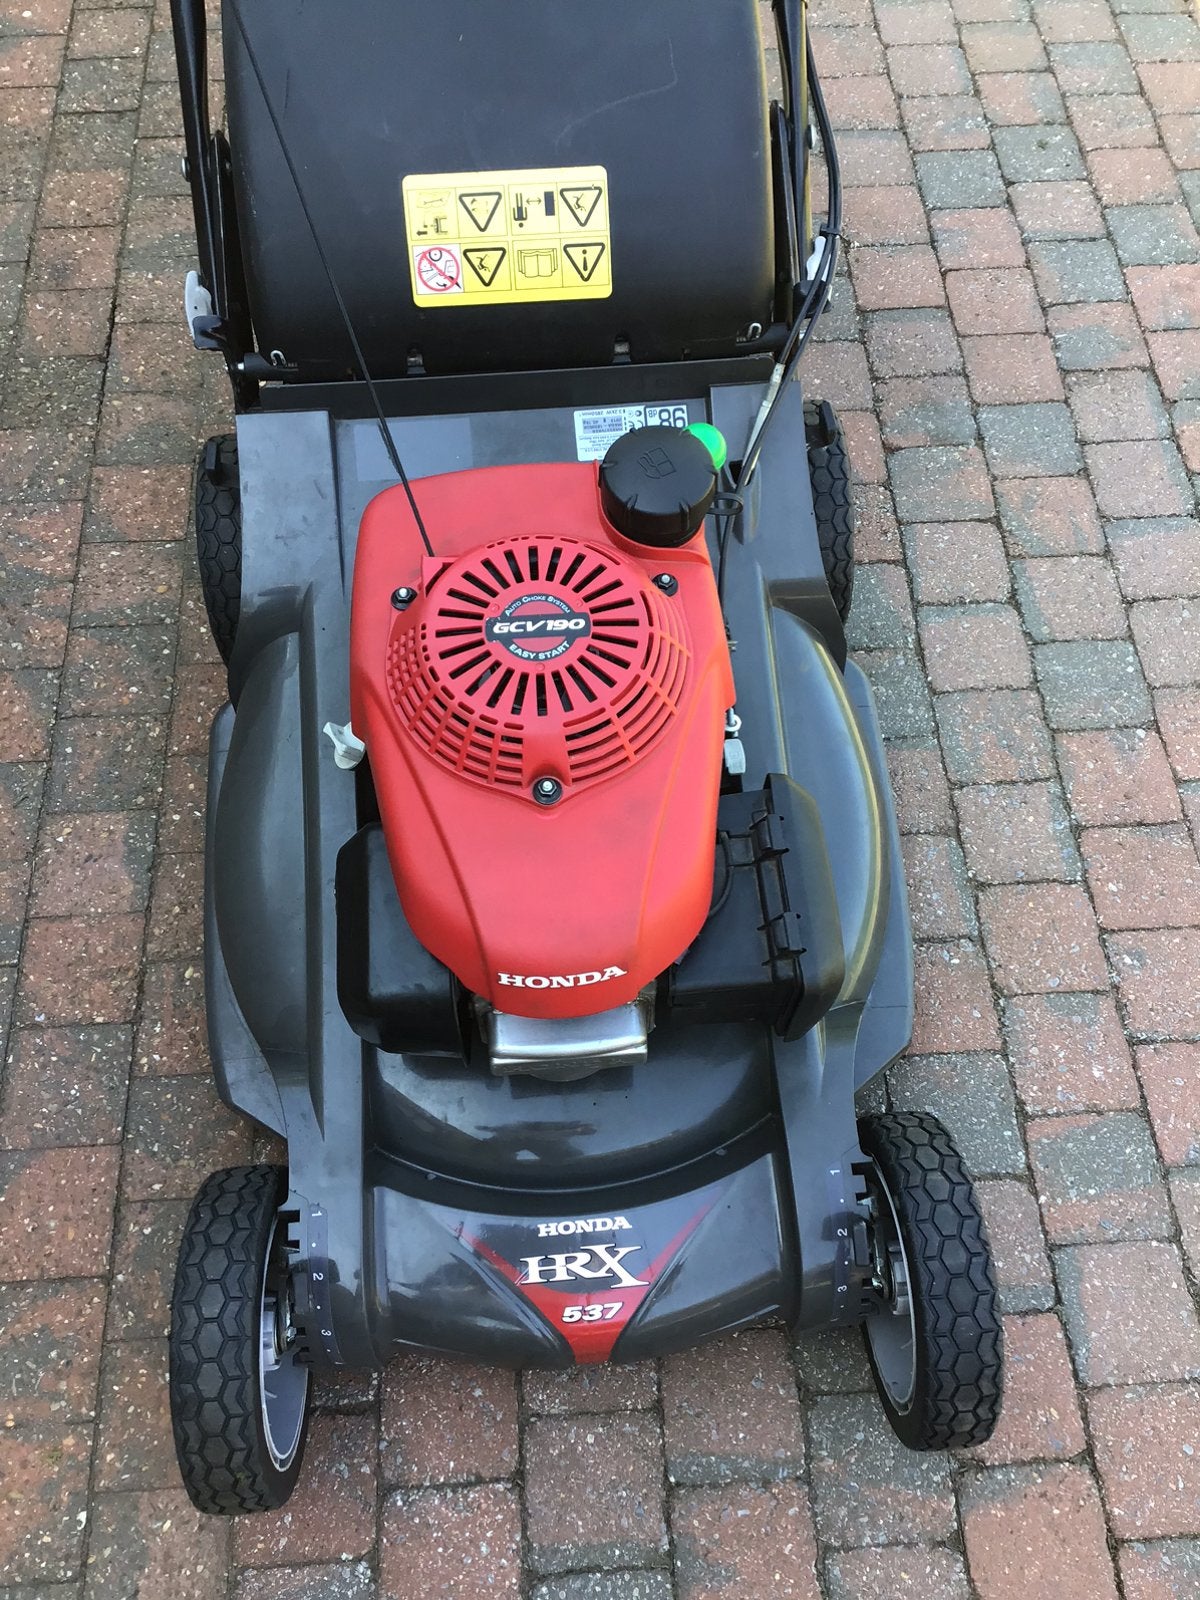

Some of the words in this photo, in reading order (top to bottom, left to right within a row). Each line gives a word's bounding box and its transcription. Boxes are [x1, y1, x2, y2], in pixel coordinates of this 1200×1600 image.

[492, 618, 586, 634] GCV190
[508, 643, 537, 660] EASY
[538, 640, 571, 660] START
[497, 965, 628, 989] HONDA
[537, 1216, 632, 1238] HONDA
[837, 1228, 848, 1237] 2
[518, 1243, 650, 1289] HRX
[312, 1272, 324, 1281] 2
[561, 1302, 623, 1323] 537
[321, 1329, 332, 1337] 3
